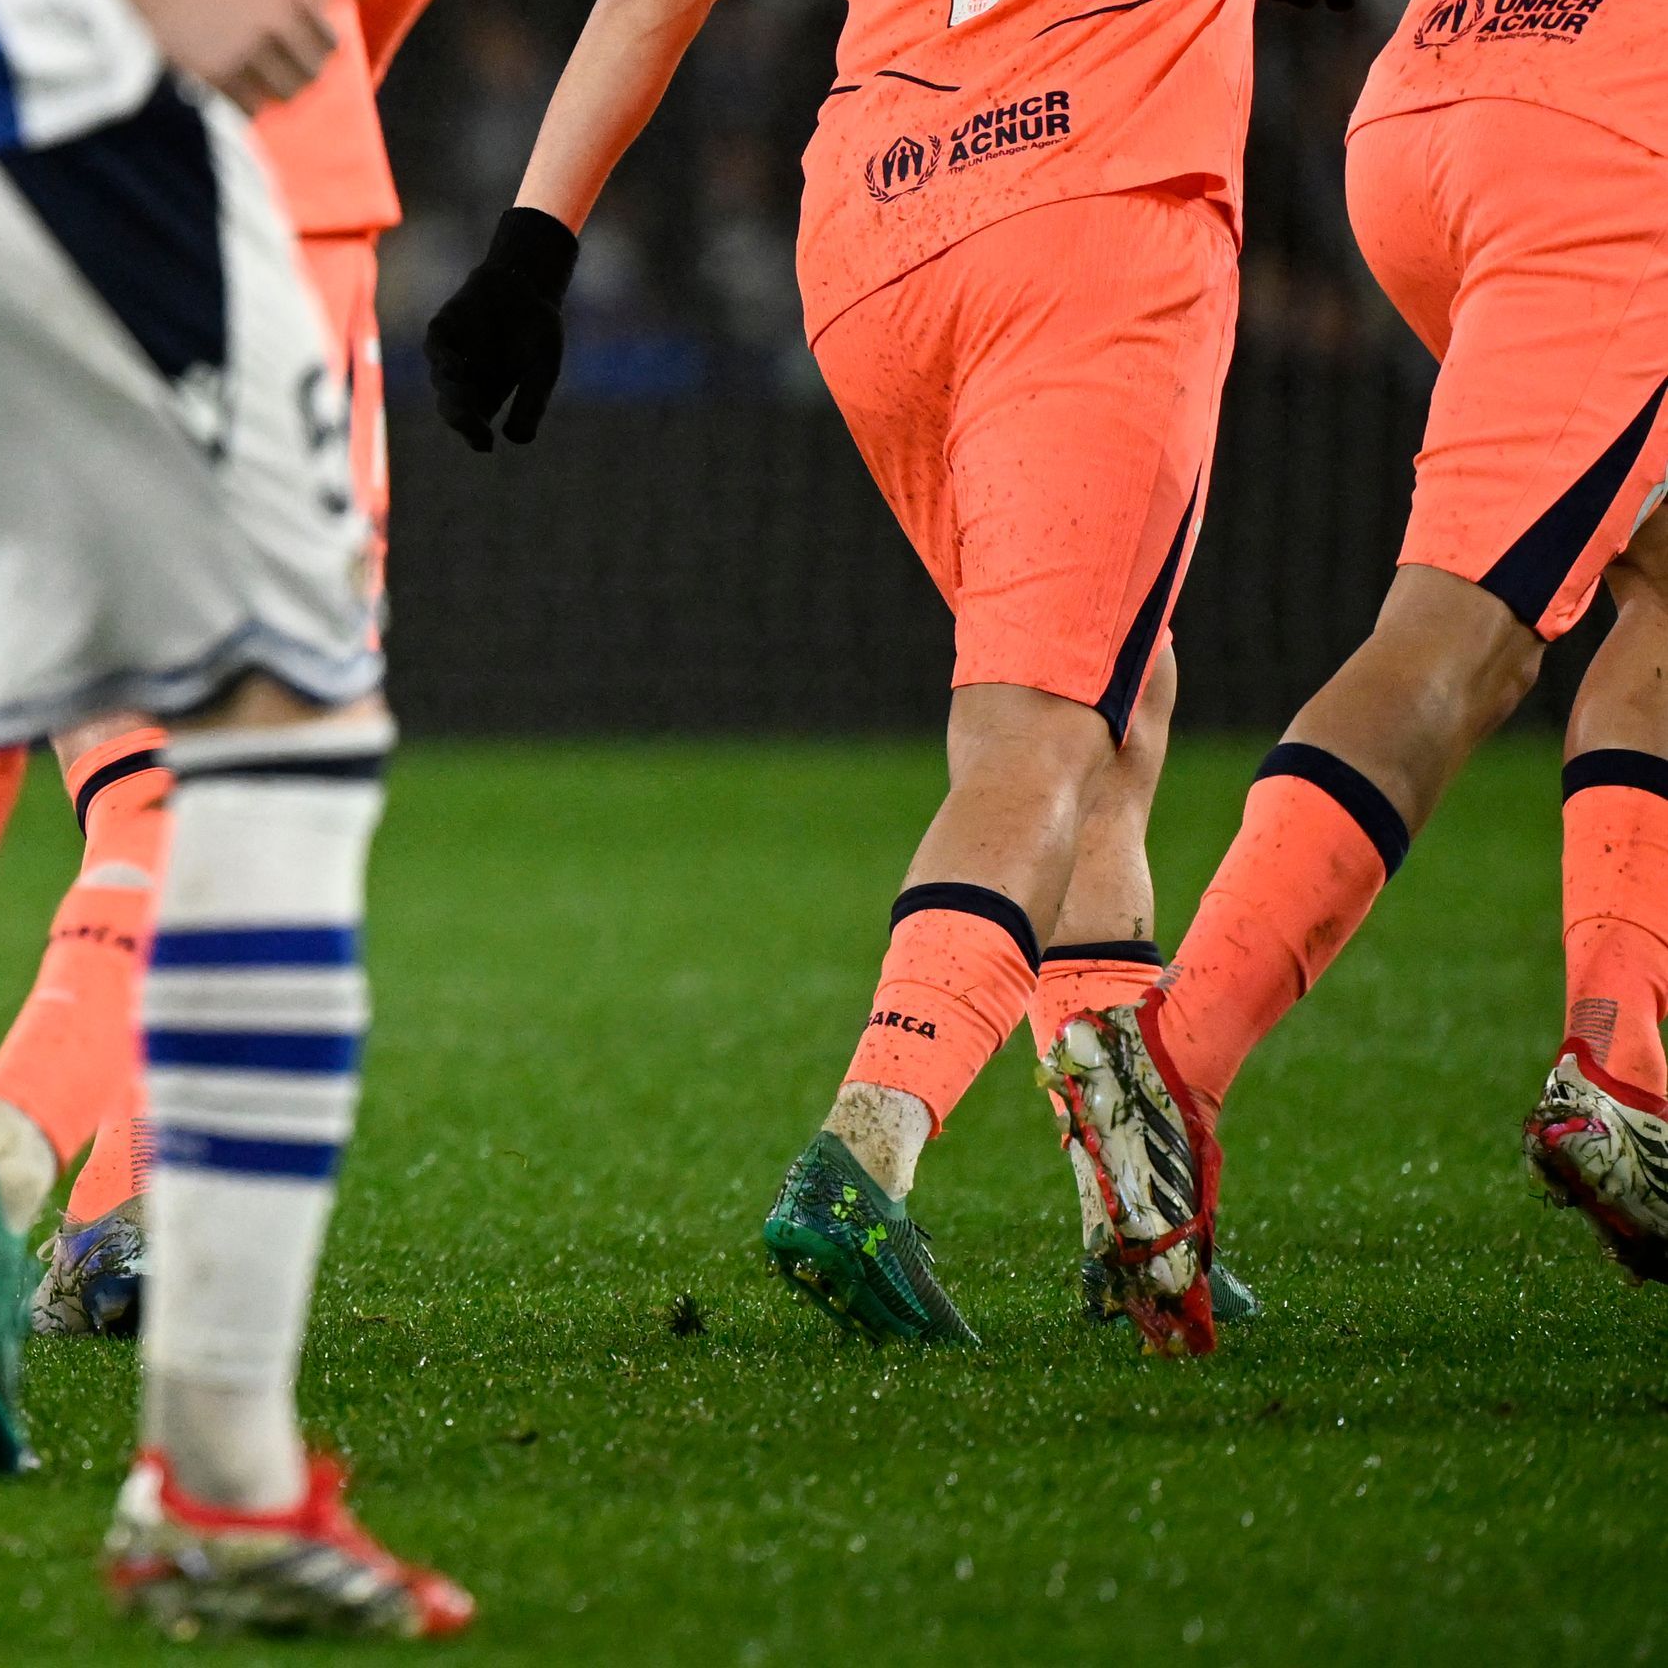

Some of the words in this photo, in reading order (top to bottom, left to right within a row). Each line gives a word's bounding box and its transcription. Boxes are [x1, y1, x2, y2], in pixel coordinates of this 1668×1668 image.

[1477, 11, 1589, 35] ACNUR
[948, 113, 1070, 166] ACNUR
[950, 90, 1070, 142] UNHCR
